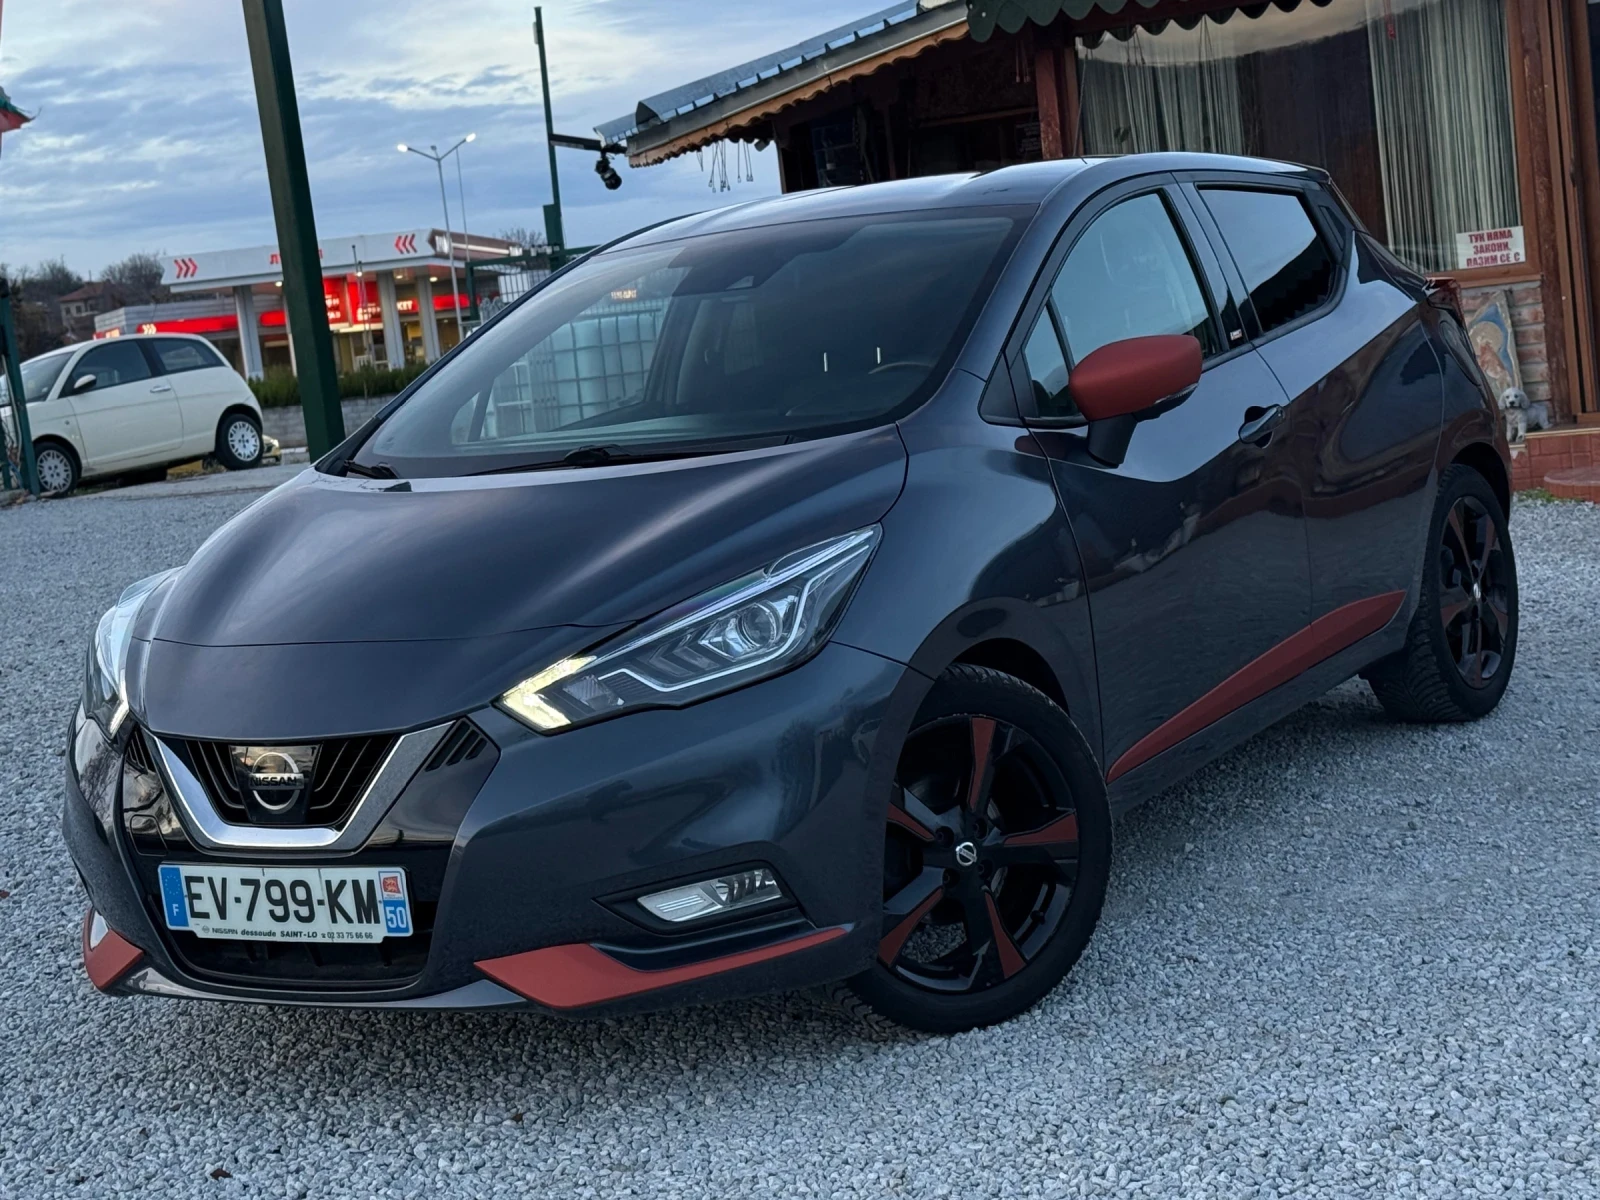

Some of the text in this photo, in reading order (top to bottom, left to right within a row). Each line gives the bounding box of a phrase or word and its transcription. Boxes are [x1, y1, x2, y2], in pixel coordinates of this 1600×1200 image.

[1468, 229, 1513, 243] ТУК НЯМА
[1500, 253, 1511, 263] СЕ
[1514, 252, 1520, 261] С
[251, 776, 297, 786] NISSAN
[184, 875, 381, 925] EV-799-KM
[172, 904, 179, 918] F
[385, 906, 407, 929] 50
[212, 927, 238, 935] NISSAN
[241, 928, 276, 937] dessoude
